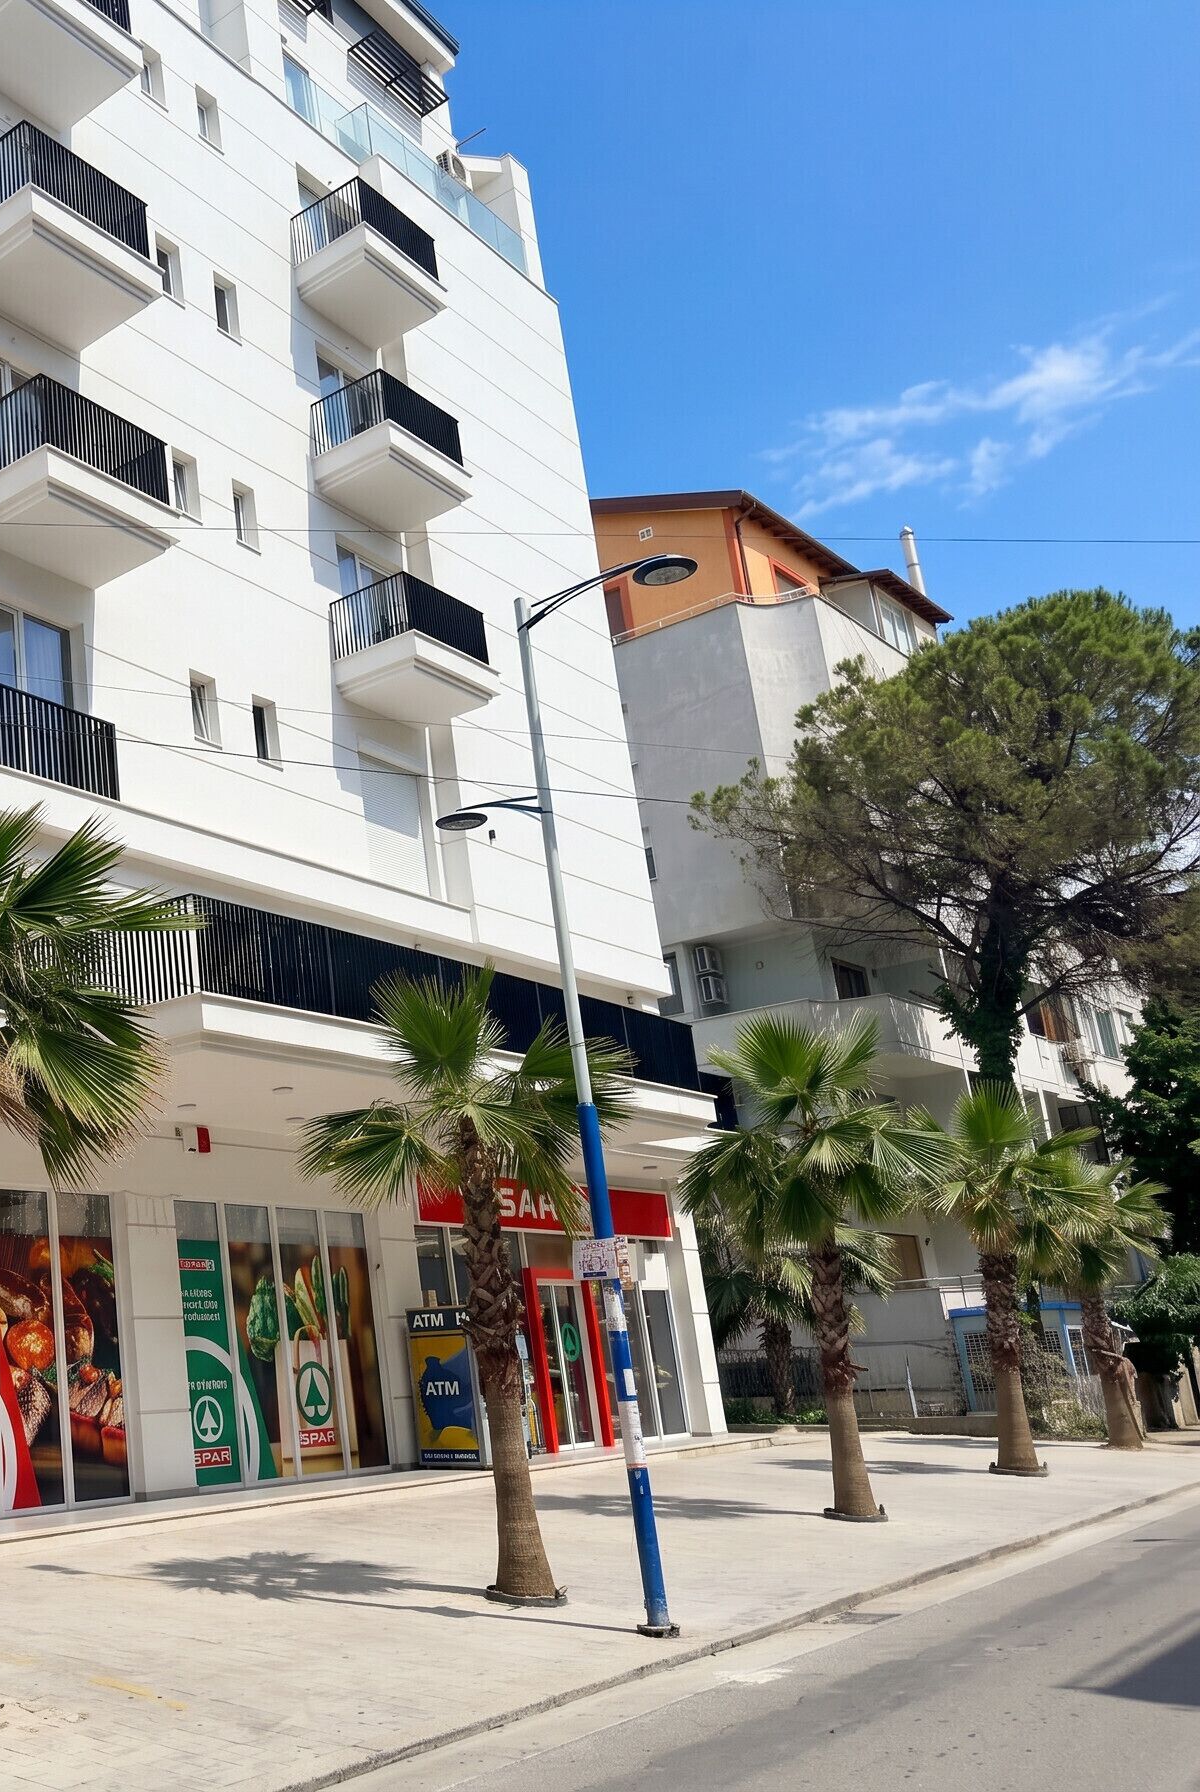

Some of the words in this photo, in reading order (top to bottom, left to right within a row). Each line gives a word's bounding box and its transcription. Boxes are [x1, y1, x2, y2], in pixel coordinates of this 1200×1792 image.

[413, 1313, 444, 1328] ATM
[426, 1381, 460, 1396] ATM
[300, 1431, 335, 1446] SPAR
[194, 1451, 230, 1465] SPAR
